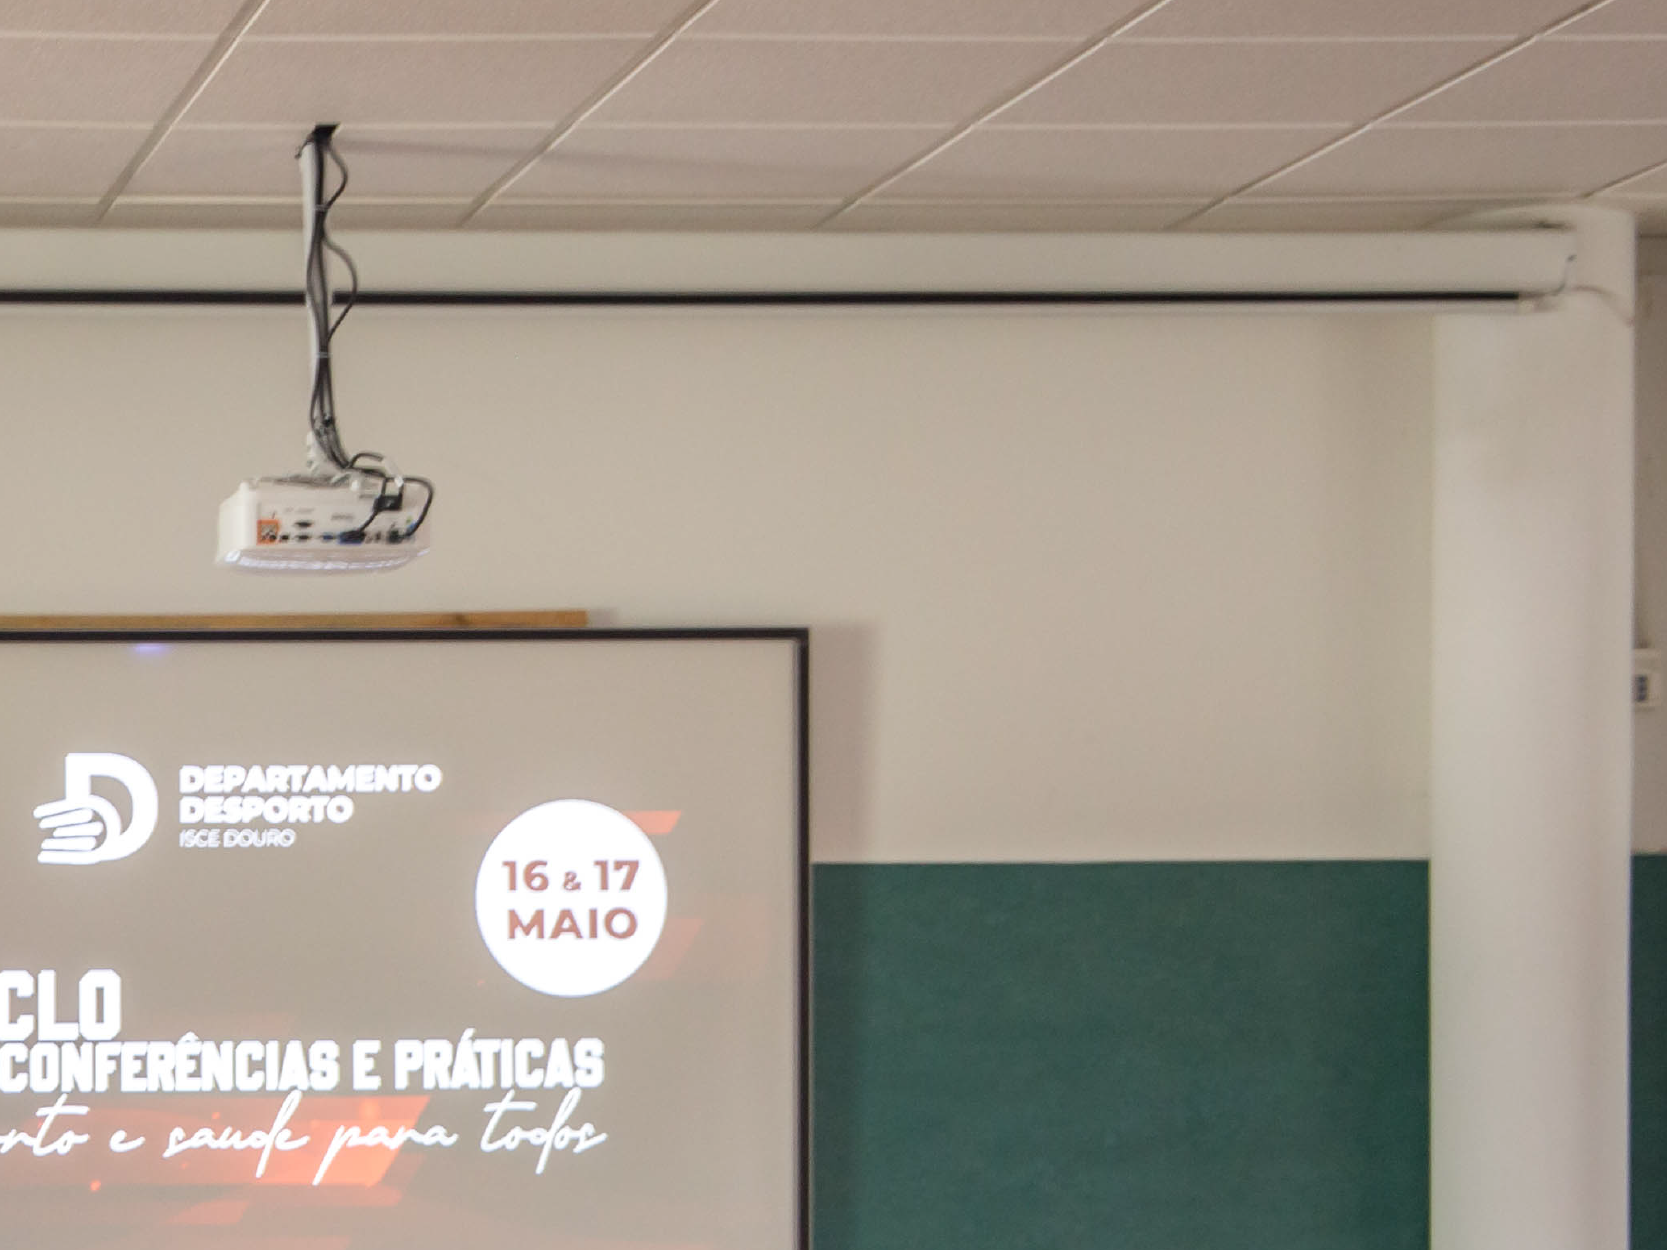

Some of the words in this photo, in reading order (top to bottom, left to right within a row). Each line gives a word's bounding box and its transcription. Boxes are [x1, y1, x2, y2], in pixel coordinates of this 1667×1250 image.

[179, 764, 443, 794] DEPARTAMENTO
[179, 795, 354, 824] DESPORTO
[179, 828, 221, 848] ISCE
[223, 828, 296, 848] DOURO
[502, 860, 549, 891] 16
[563, 871, 581, 891] &
[593, 860, 640, 891] 17
[507, 907, 638, 940] MAIO
[352, 1039, 382, 1090] E
[394, 1027, 605, 1090] PRÁTICAS
[109, 1129, 146, 1152] e
[312, 1123, 459, 1186] para
[480, 1086, 608, 1175] todos
